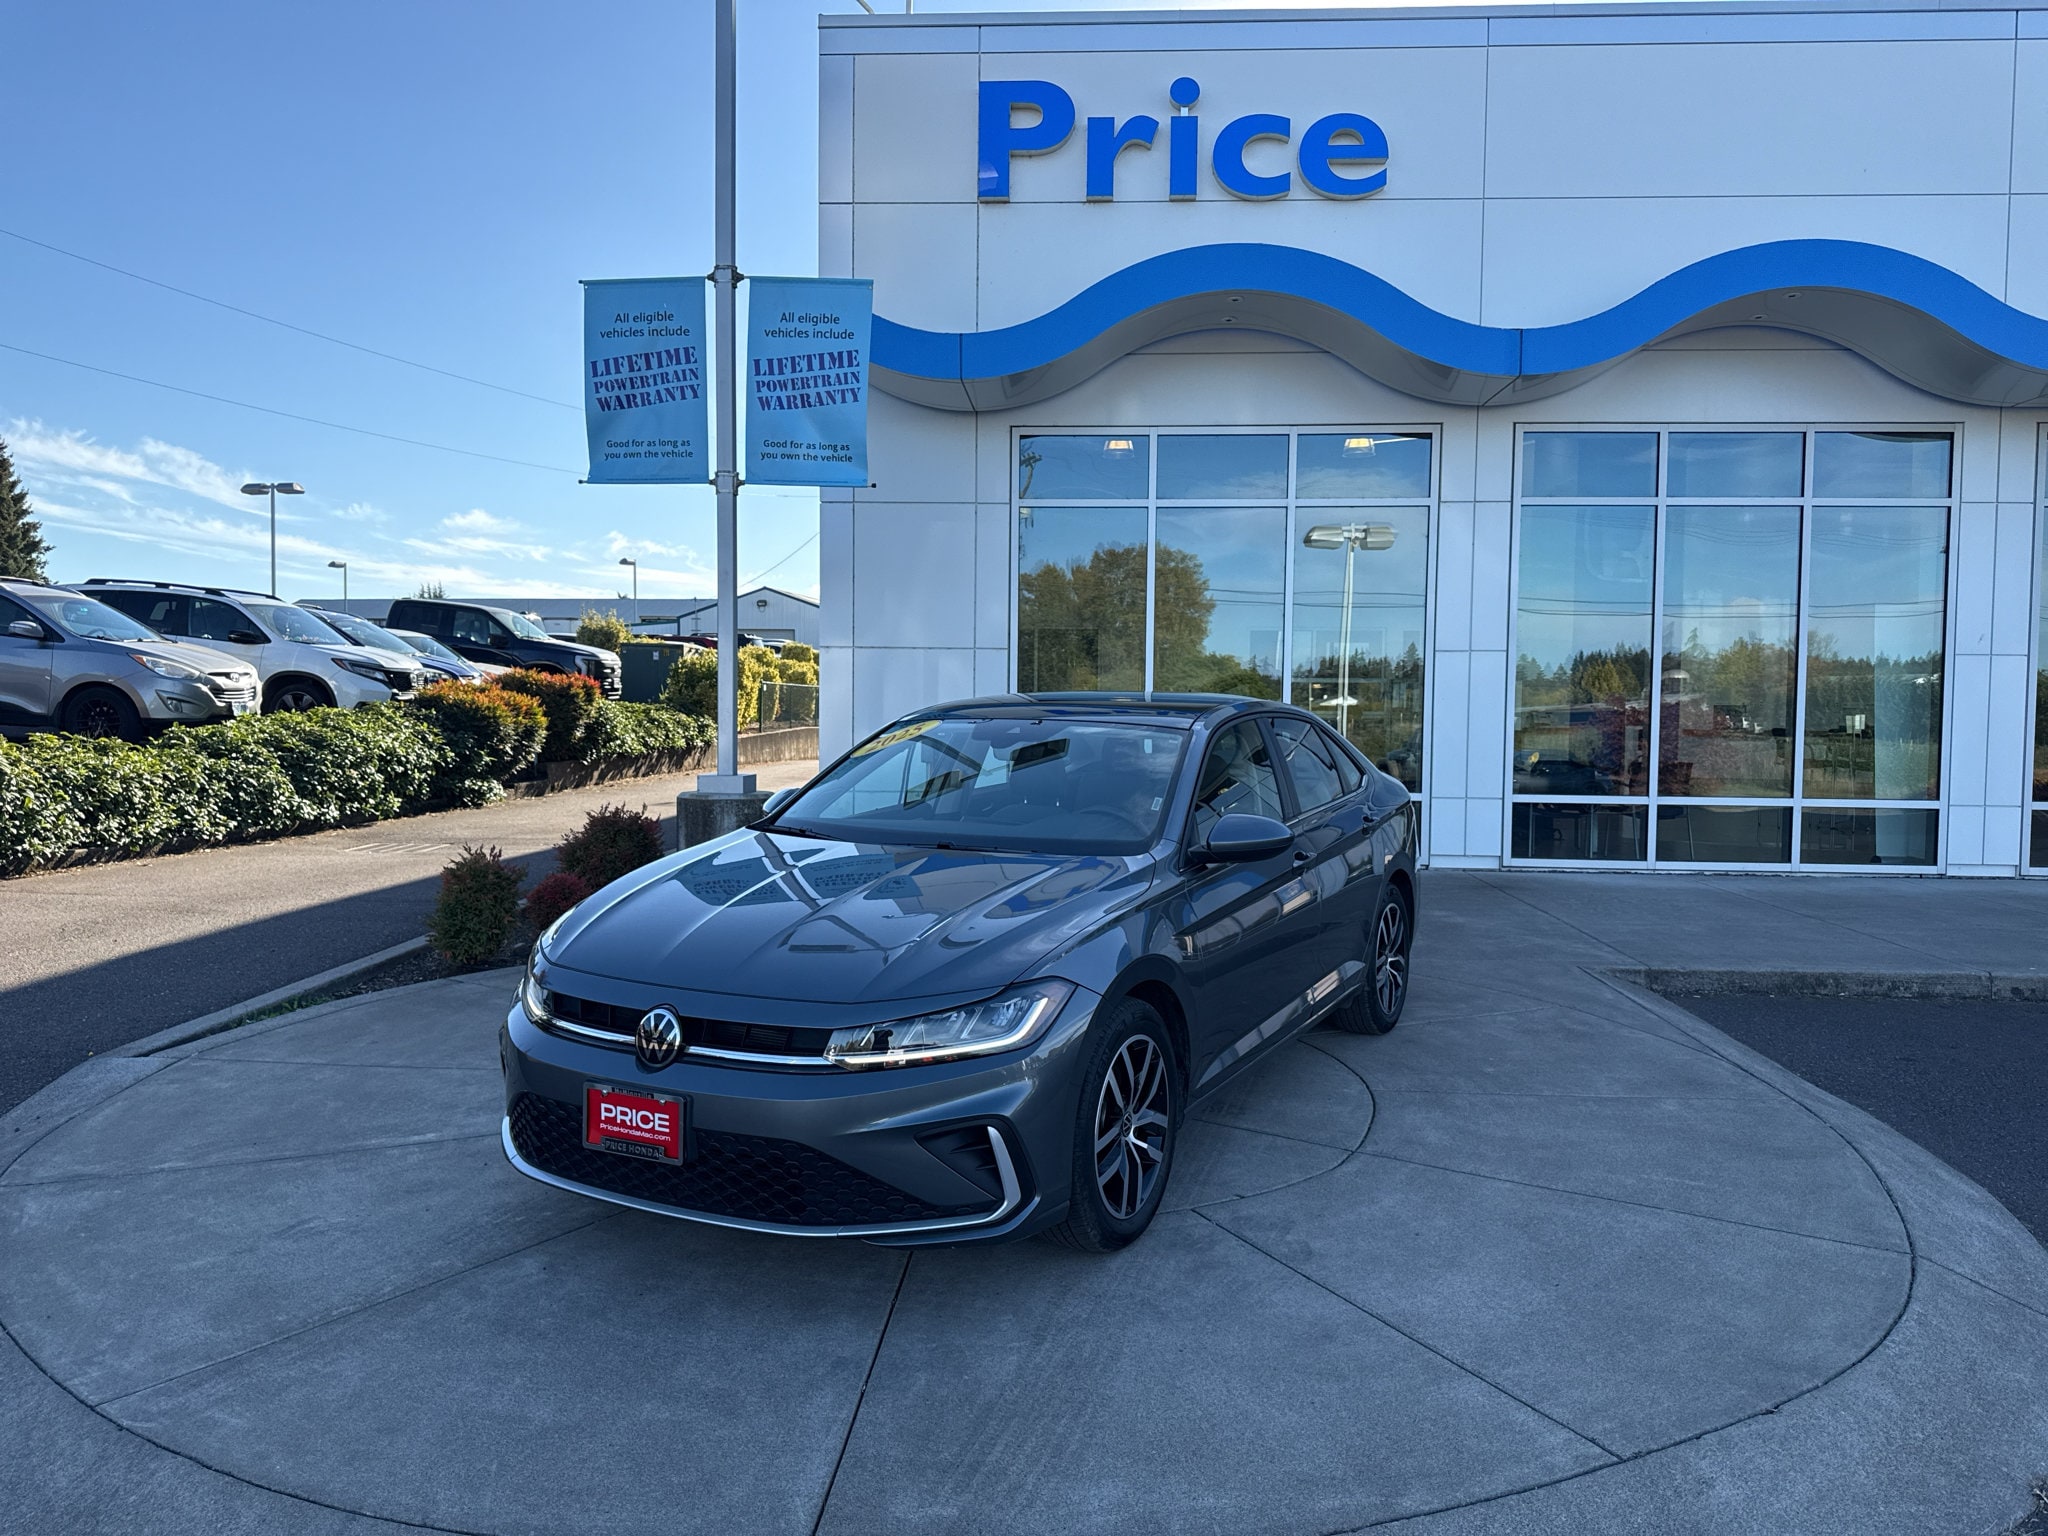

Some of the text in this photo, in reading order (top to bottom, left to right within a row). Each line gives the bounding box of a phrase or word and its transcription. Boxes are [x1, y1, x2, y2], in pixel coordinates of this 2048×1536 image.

[977, 77, 1389, 202] Price
[614, 310, 675, 325] All eligible
[779, 312, 841, 327] All eligible
[600, 325, 691, 339] vehicles include
[764, 327, 855, 340] vehicles include
[590, 346, 698, 378] LIFETIME
[752, 349, 860, 377] LIFETIME
[593, 367, 699, 394] POWERTRAIN
[755, 371, 860, 393] POWERTRAIN
[596, 383, 701, 412] WARRANTY
[757, 387, 861, 411] WARRANTY
[606, 439, 630, 448] Good
[631, 439, 645, 447] for
[658, 438, 678, 448] long
[763, 440, 787, 448] Good
[790, 440, 803, 449] for
[818, 442, 838, 452] long
[604, 452, 621, 461] you
[644, 450, 659, 458] the
[661, 449, 694, 458] vehicle
[760, 451, 853, 463] you own the vehicle
[600, 1103, 670, 1133] PRICE
[600, 1123, 671, 1142] PriceHondaMac.com
[605, 1140, 659, 1158] PRICE HONDA
